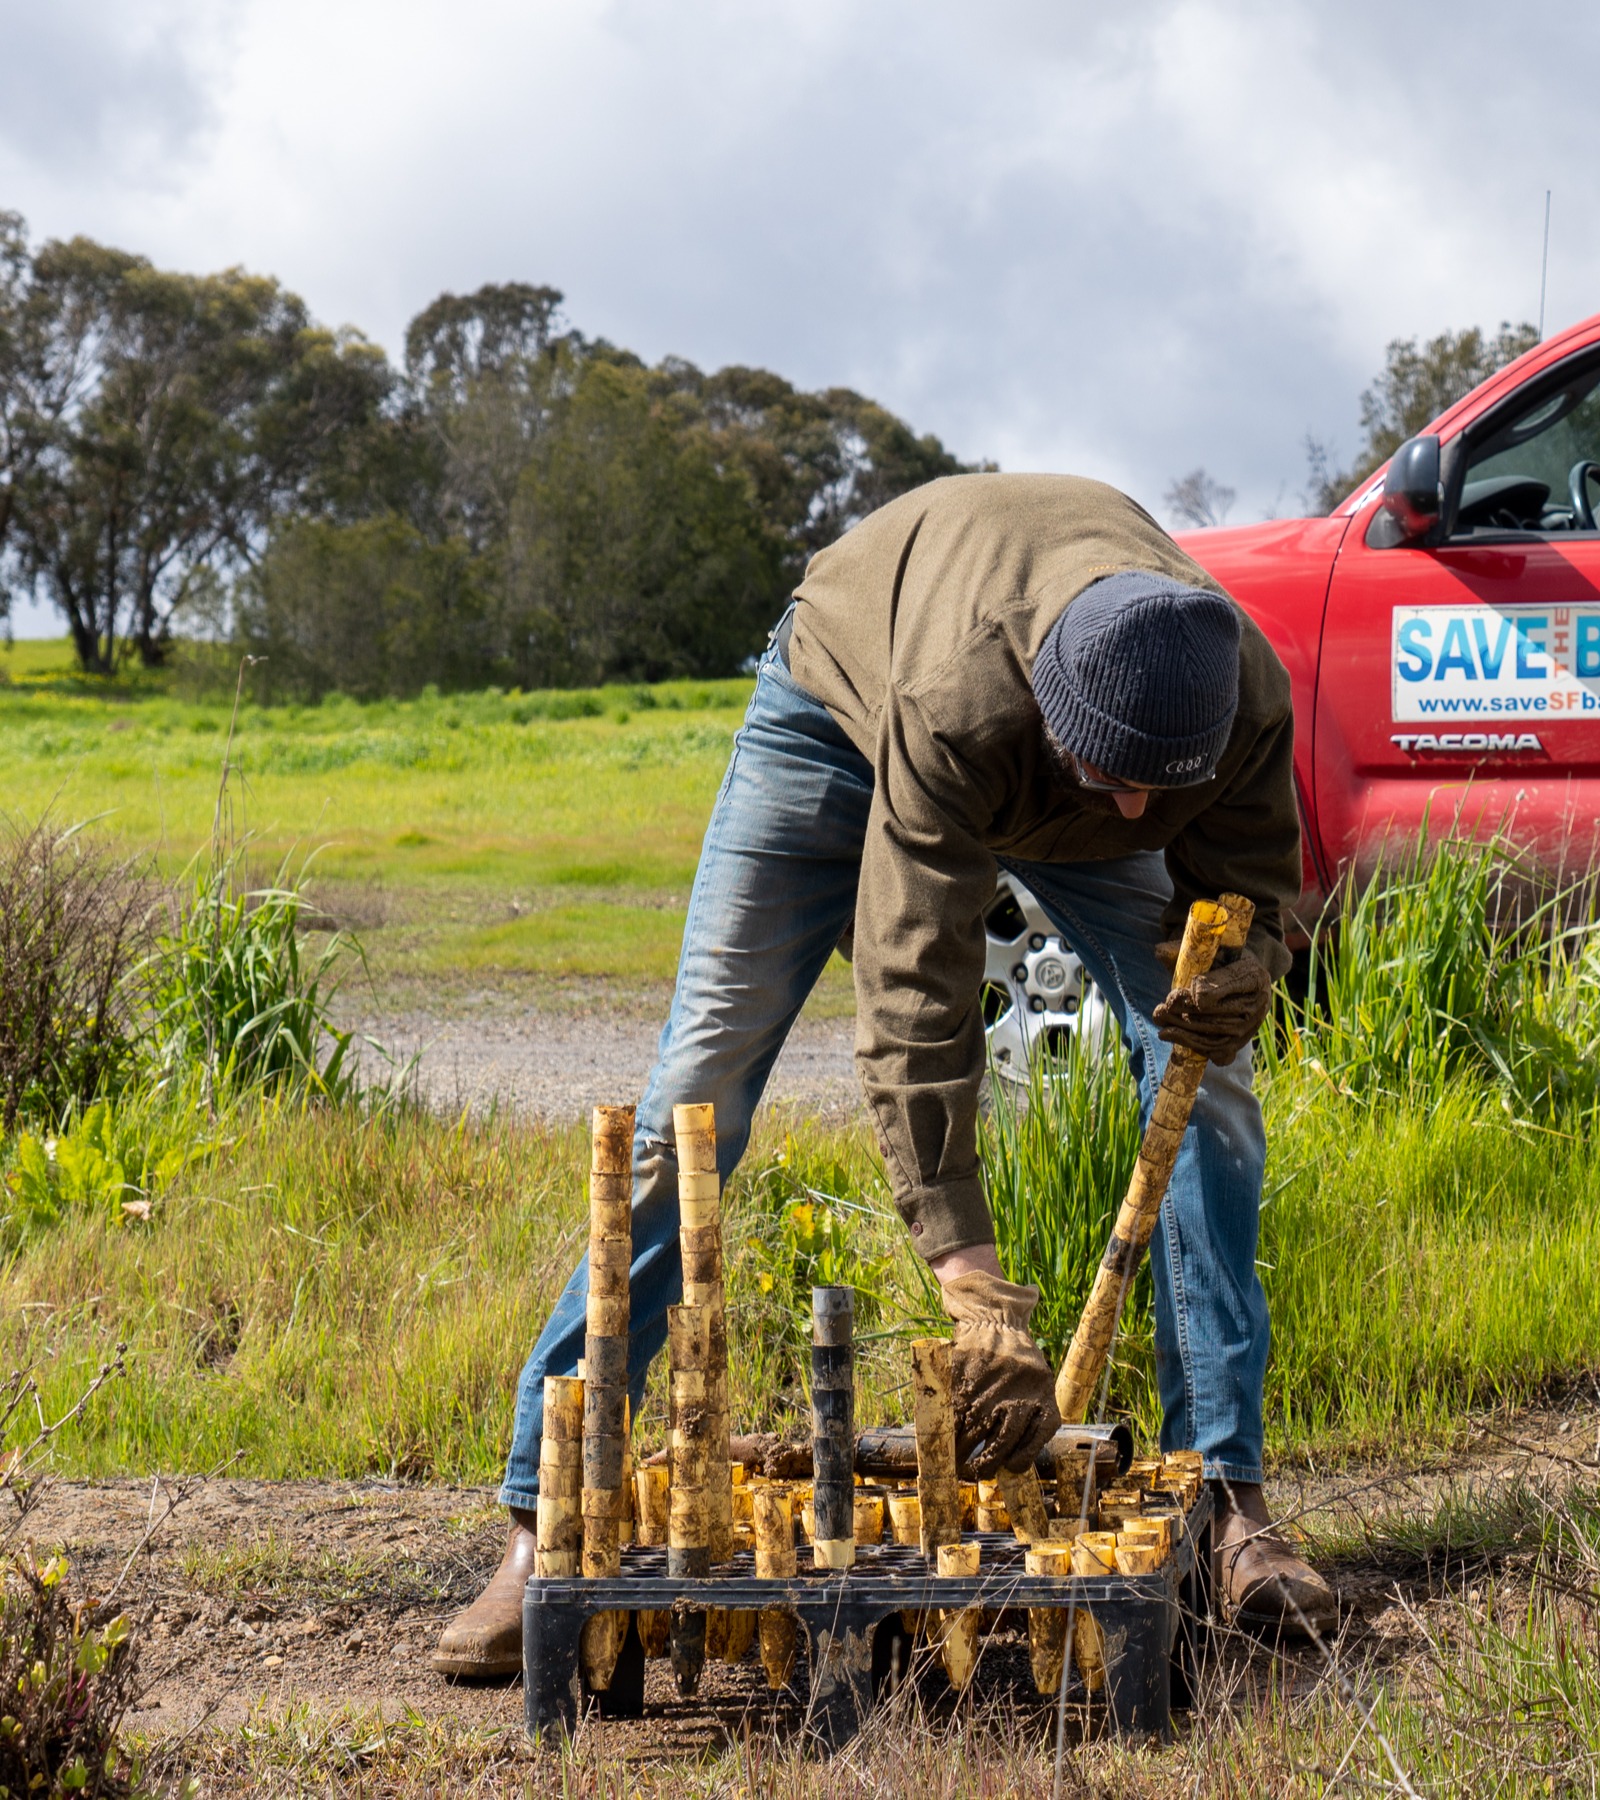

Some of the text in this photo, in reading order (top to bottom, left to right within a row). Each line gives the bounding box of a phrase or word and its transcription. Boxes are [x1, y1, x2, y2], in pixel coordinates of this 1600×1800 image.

[1398, 617, 1549, 682] SAVE
[1554, 606, 1570, 678] THE
[1390, 733, 1542, 751] TACOMA
